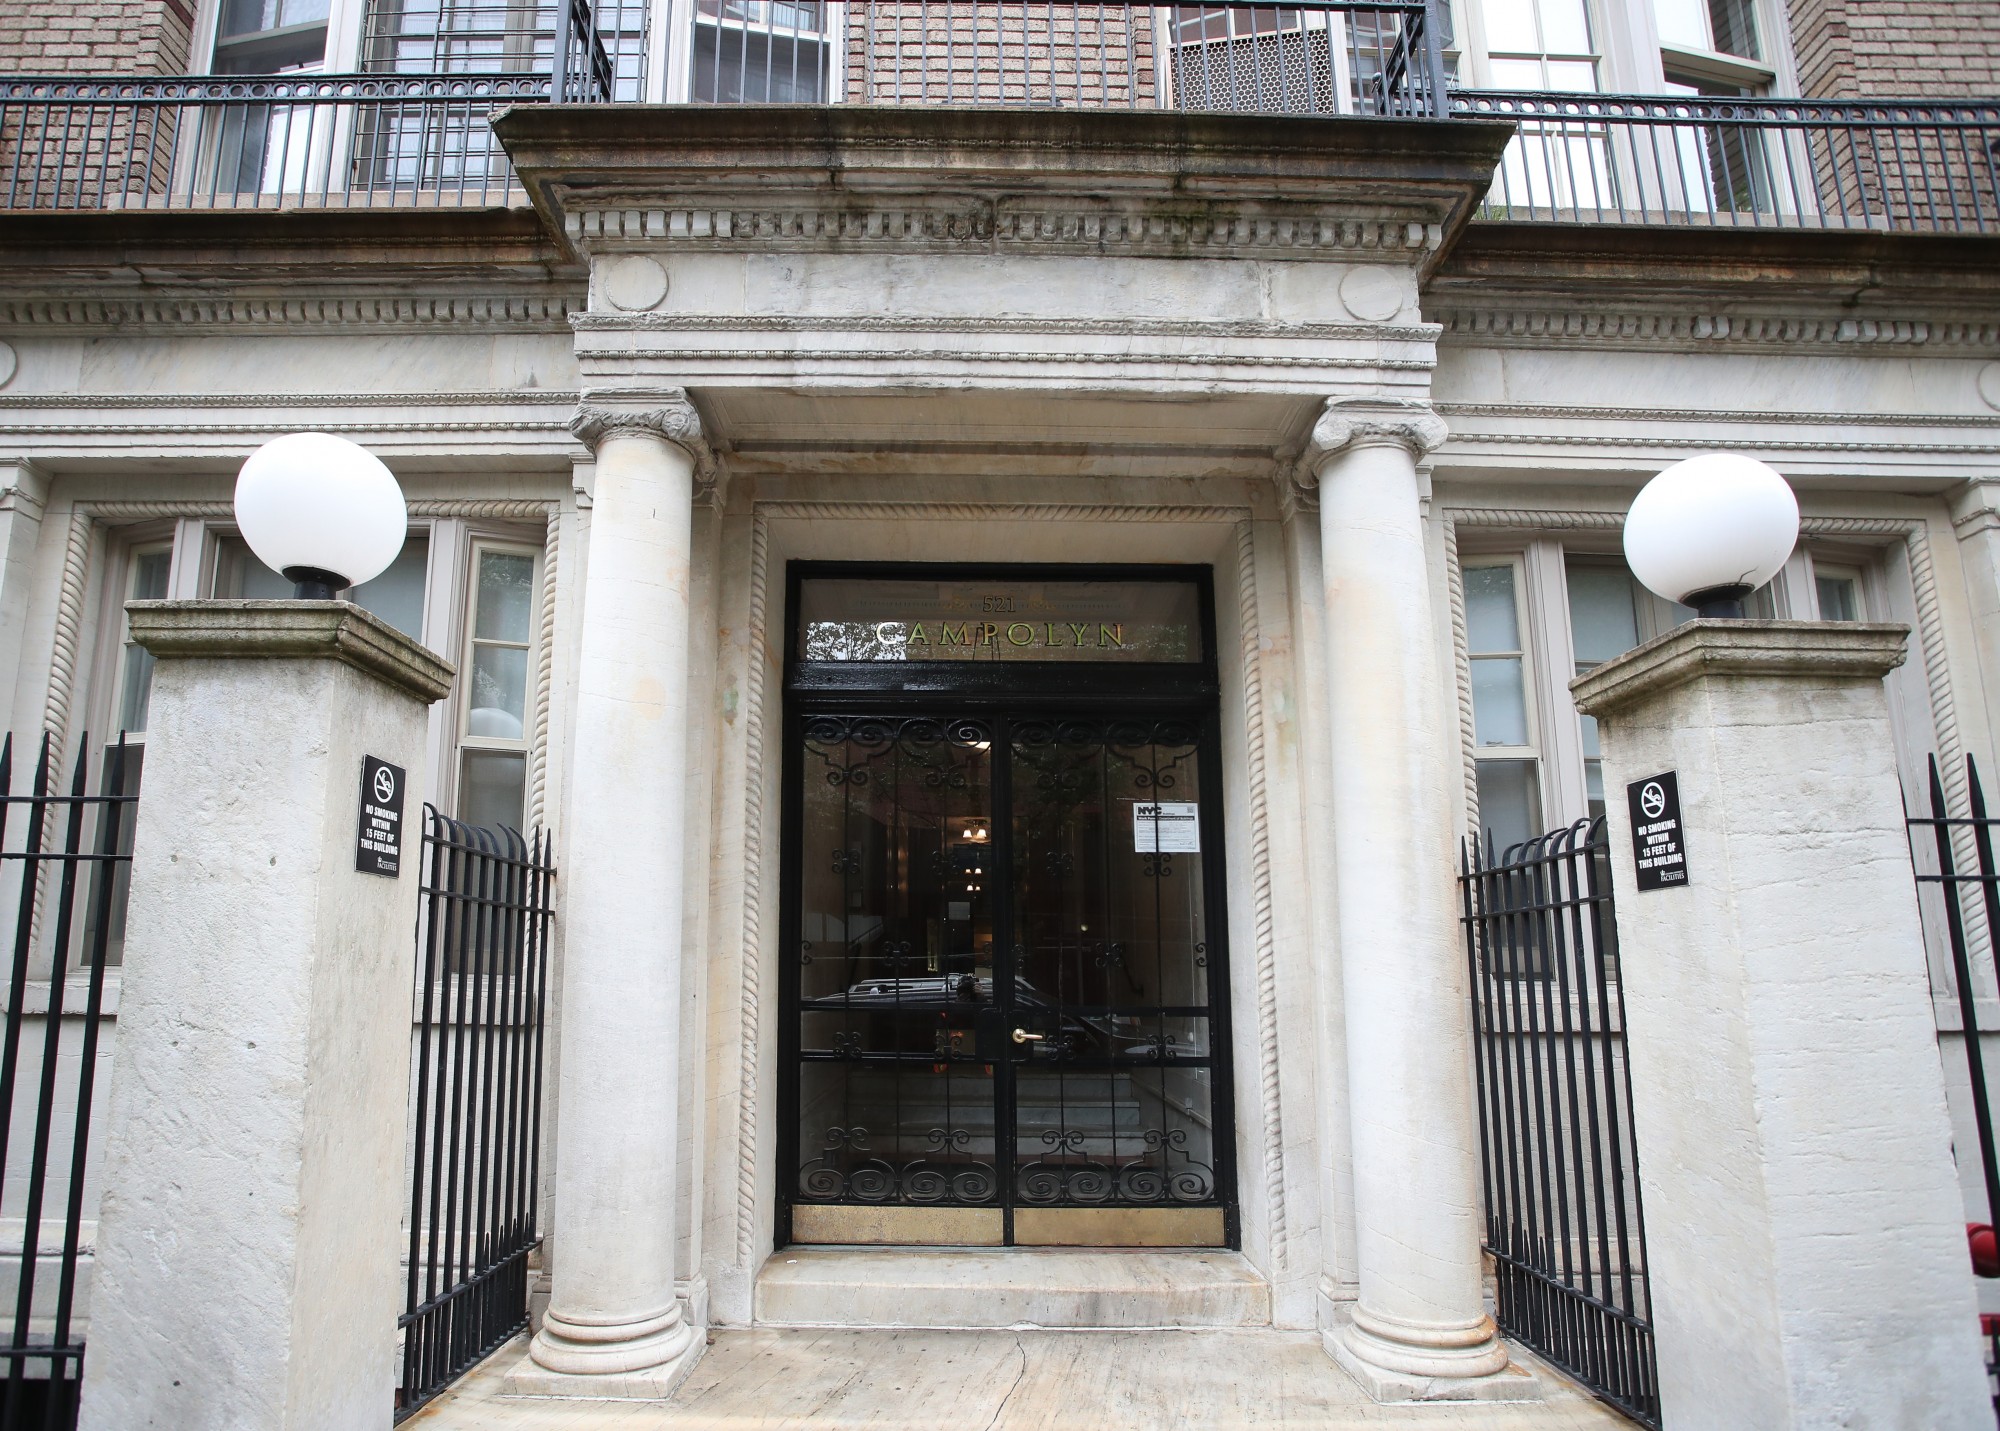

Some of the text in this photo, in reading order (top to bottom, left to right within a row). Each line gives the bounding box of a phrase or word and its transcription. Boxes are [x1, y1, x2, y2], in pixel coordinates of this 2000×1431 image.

[982, 595, 1016, 612] 521
[876, 621, 1124, 648] CAMPOLYN
[366, 804, 398, 822] NO SMOKING
[1138, 806, 1162, 814] NYC
[372, 817, 390, 830] WITHIN
[1638, 819, 1676, 836] NO SMOKING
[366, 828, 394, 843] 15 FEET OF
[1646, 832, 1670, 845] WITHIN
[360, 838, 398, 856] THIS BUILDING
[1642, 842, 1676, 857] 15 FEET OF
[1638, 853, 1682, 870] THIS BUILDING
